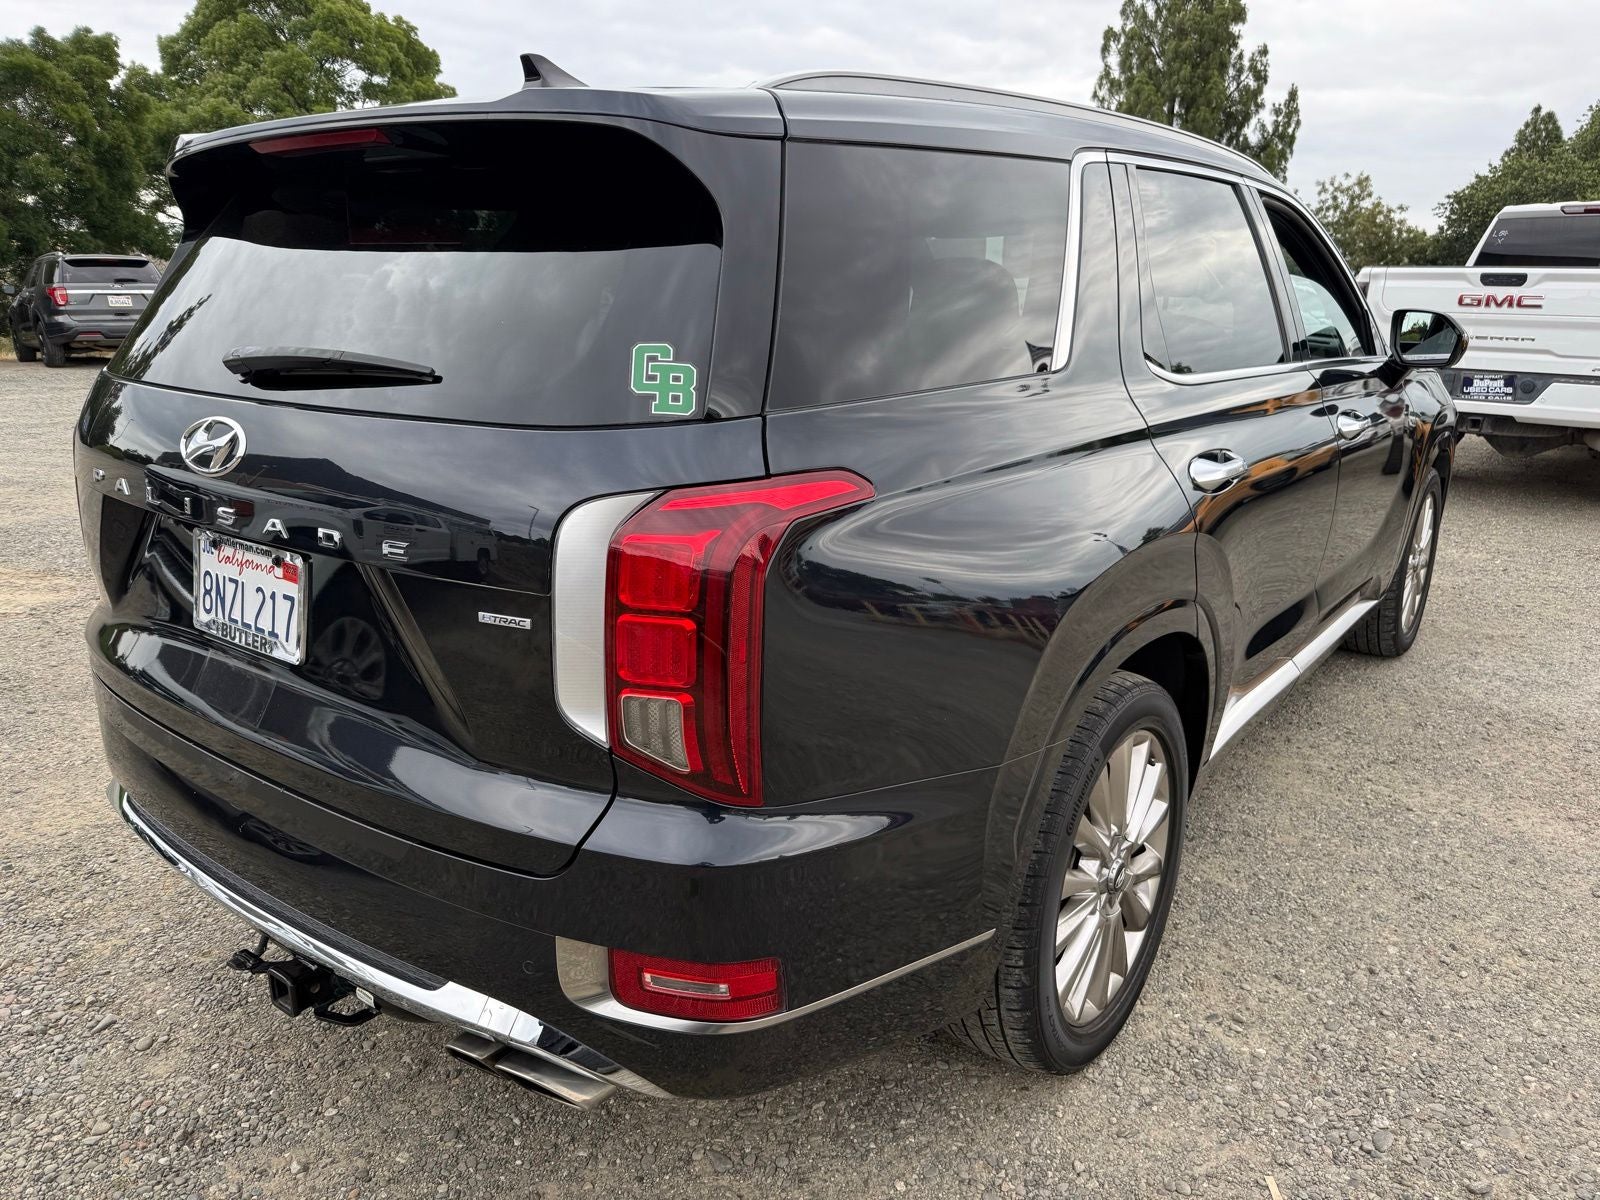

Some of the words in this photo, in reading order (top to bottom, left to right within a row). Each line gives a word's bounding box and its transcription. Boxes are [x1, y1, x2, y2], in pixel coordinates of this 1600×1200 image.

[1457, 293, 1544, 309] GMC
[92, 467, 410, 562] PALISADE
[216, 545, 283, 579] California
[203, 570, 295, 643] 8NZL217
[221, 622, 267, 653] BUTLER
